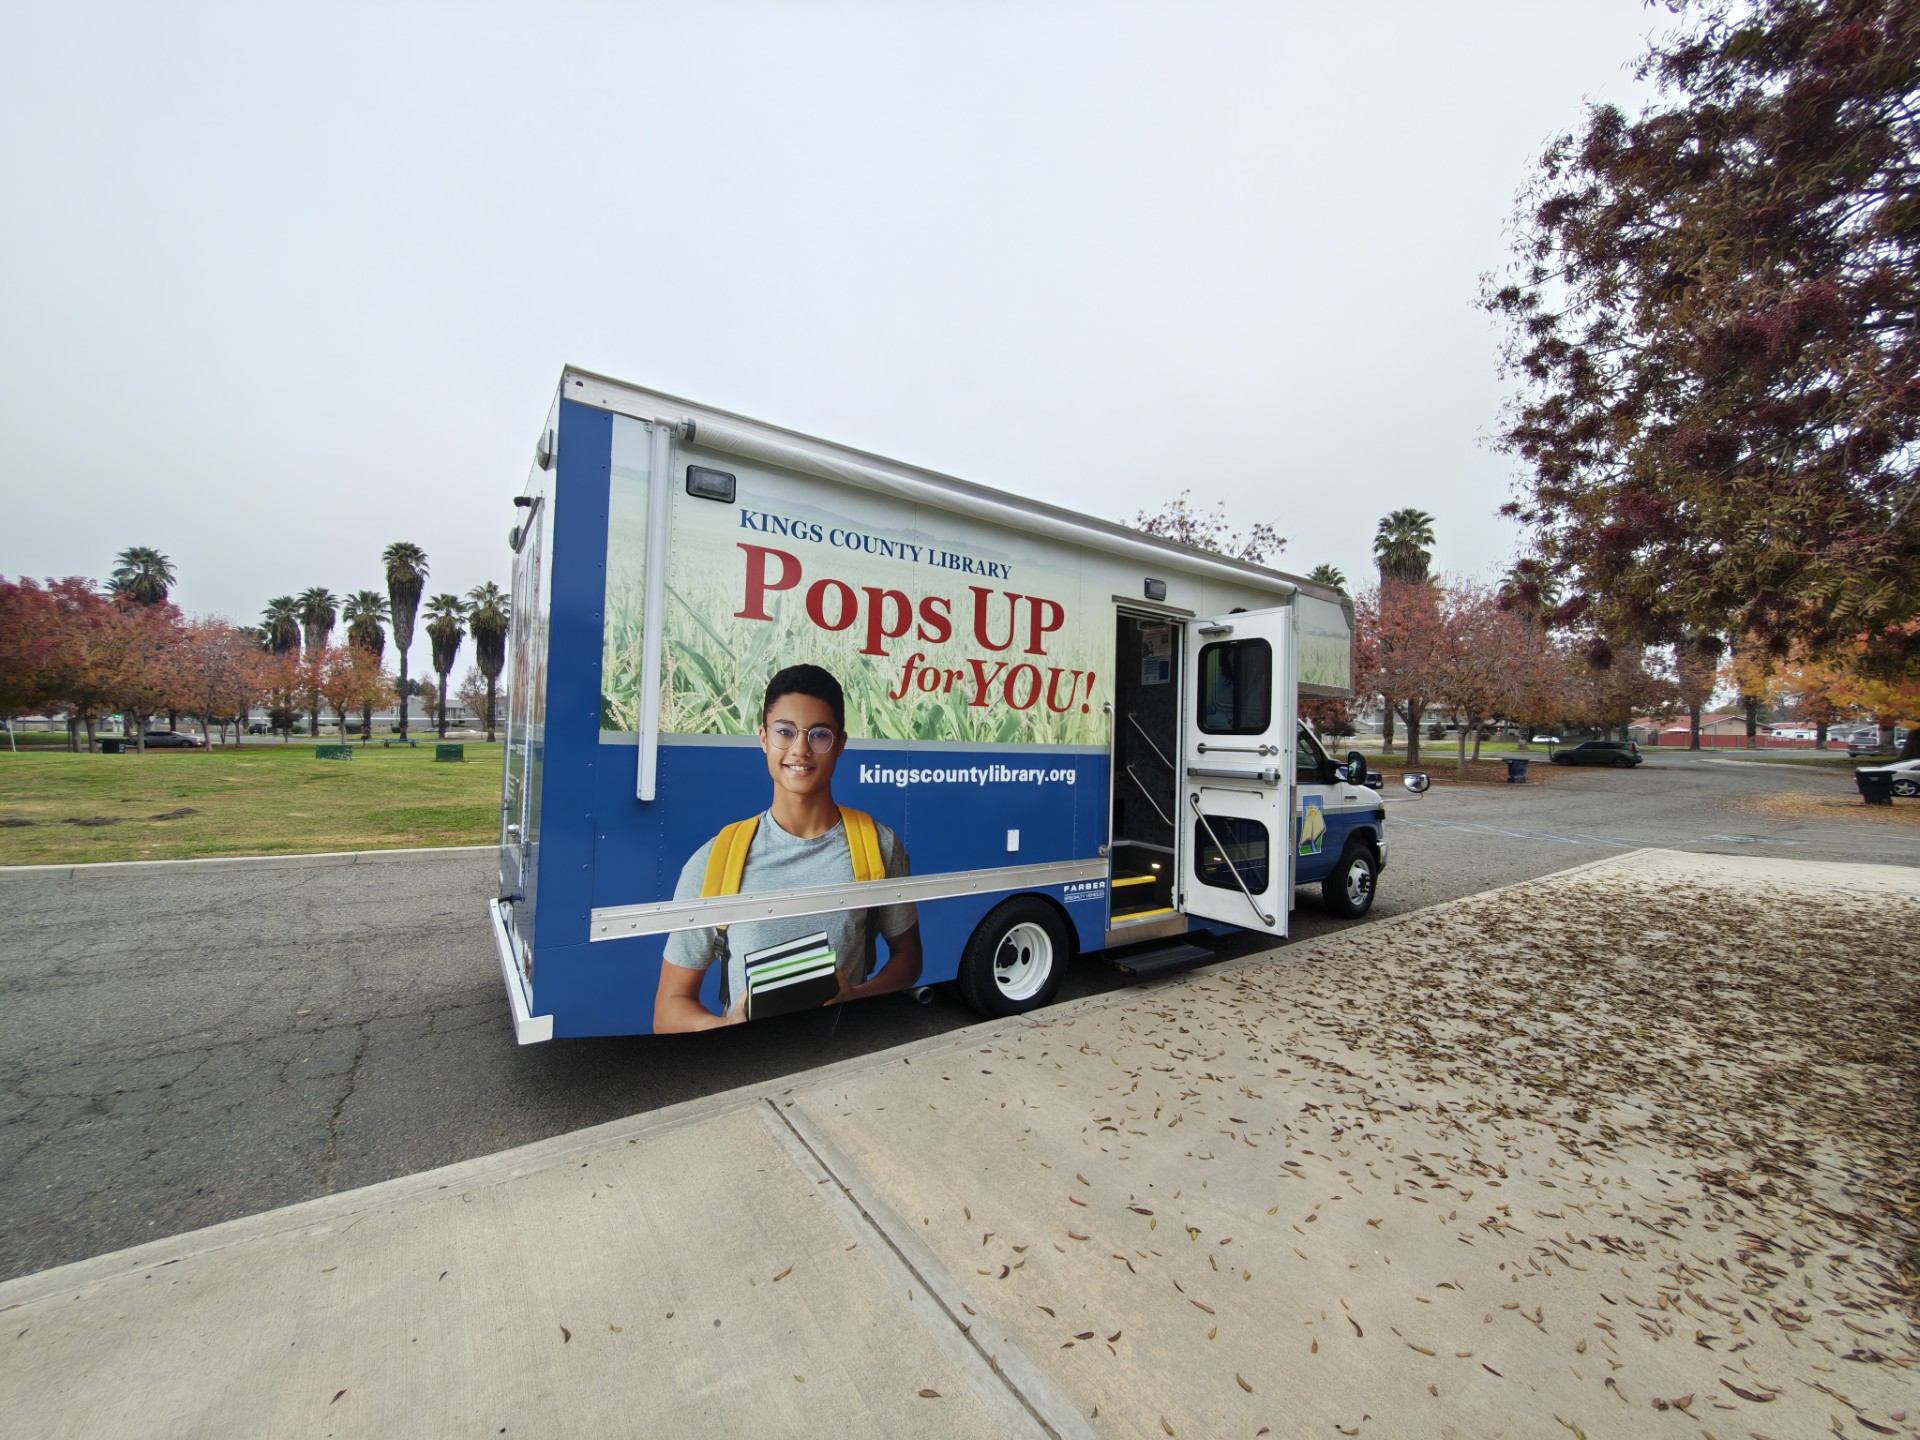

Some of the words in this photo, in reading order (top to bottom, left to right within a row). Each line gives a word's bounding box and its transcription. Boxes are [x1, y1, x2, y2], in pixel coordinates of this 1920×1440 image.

[739, 509, 823, 542] KINGS
[829, 528, 923, 562] COUNTY
[928, 548, 1012, 580] LIBRARY
[734, 542, 952, 656] Pops
[968, 585, 1065, 656] UP
[889, 653, 963, 700] for
[966, 658, 1096, 714] YOU!
[859, 764, 1076, 787] kingscountylibrary.org
[1063, 881, 1105, 893] FARBER
